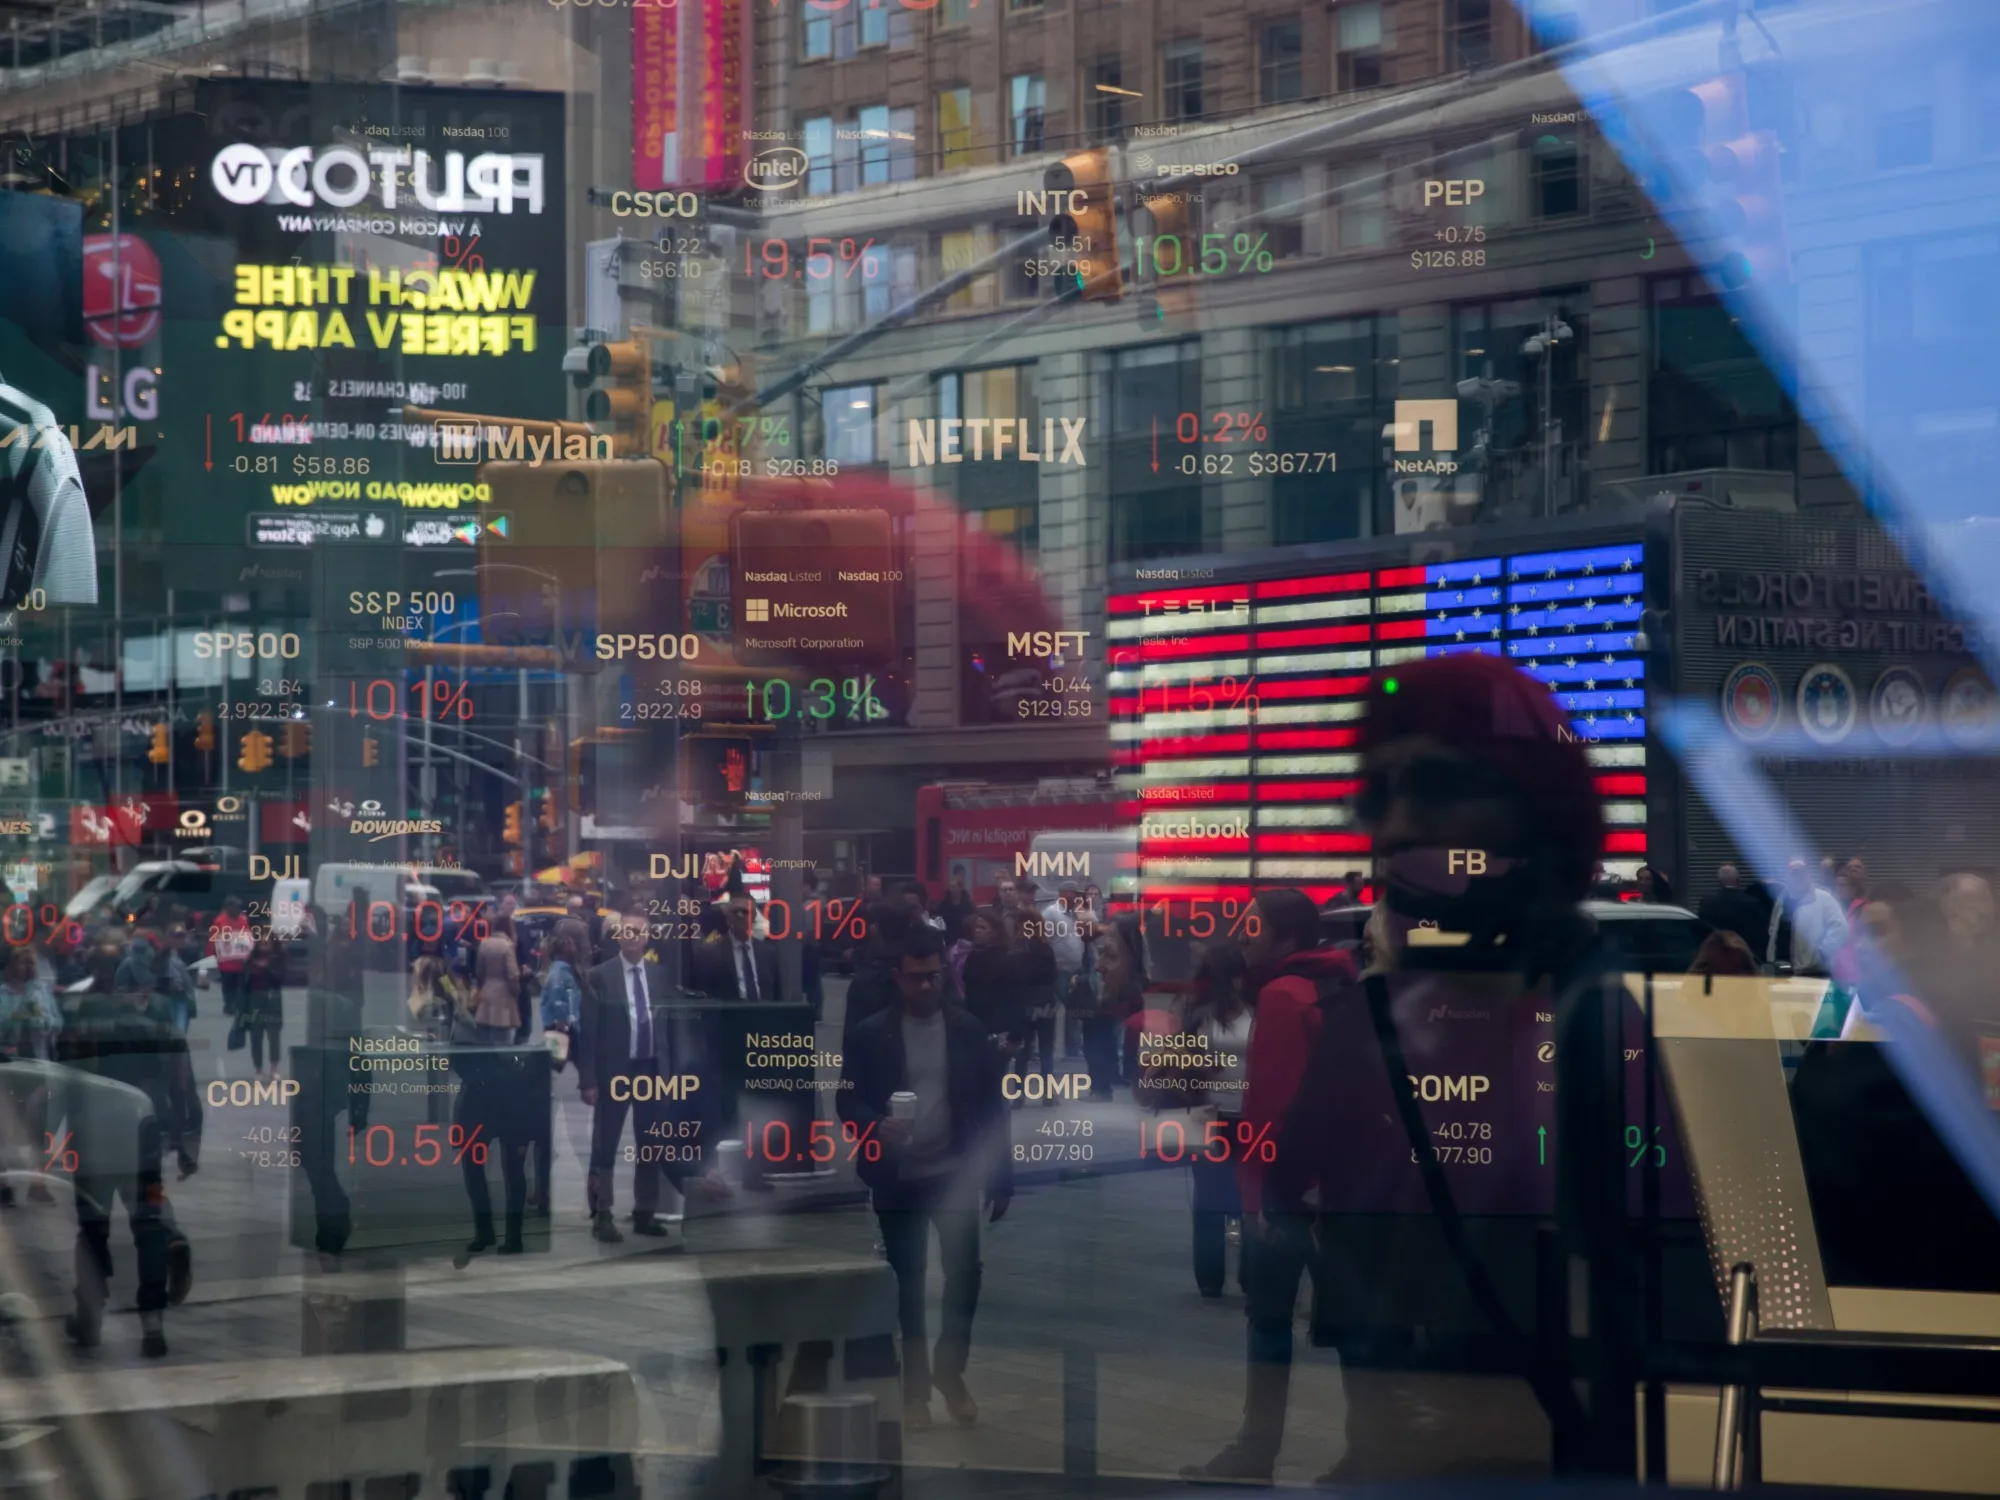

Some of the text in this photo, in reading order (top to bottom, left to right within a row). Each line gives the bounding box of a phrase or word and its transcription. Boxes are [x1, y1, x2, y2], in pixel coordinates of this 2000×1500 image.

[1531, 112, 1576, 124] Nasdaq
[443, 125, 509, 138] Nasdaq 100
[742, 129, 786, 142] Nasdaq
[1134, 126, 1178, 137] Nasdaq
[752, 156, 798, 177] intel
[1157, 163, 1240, 177] PEPSICO
[1016, 189, 1089, 216] INTC
[1424, 179, 1485, 207] PEP
[611, 191, 699, 218] CSCO
[1048, 235, 1092, 253] -5.51
[1434, 226, 1487, 244] +0.75
[761, 237, 879, 280] 9.5%
[1152, 232, 1274, 276] 0.5%
[1410, 249, 1487, 270] $126.88
[639, 260, 702, 279] $56.10
[1024, 258, 1092, 279] $52.09
[86, 364, 159, 420] LG
[1175, 412, 1268, 444] 0.2%
[487, 424, 614, 467] Mylan
[907, 416, 1087, 467] NETFLIX
[228, 453, 371, 476] -0.81 $58.86
[699, 456, 839, 478] +0.18 $26.86
[1173, 451, 1338, 478] -0.62 $367.71
[1393, 460, 1458, 475] NetApp
[744, 571, 788, 584] Nasdaq
[788, 570, 822, 582] Listed
[838, 570, 903, 583] Nasdaq 100
[1135, 568, 1214, 580] Nasdaq Listed
[349, 591, 456, 615] S&P 500
[772, 602, 848, 619] Microsoft
[382, 616, 424, 630] INDEX
[193, 631, 301, 659] SP500
[348, 638, 435, 650] S&P 500 Index
[595, 633, 700, 660] SP500
[745, 637, 865, 651] Microsoft Corporation
[1006, 630, 1091, 657] MSFT
[255, 679, 302, 696] -3.64
[654, 679, 702, 697] -3.68
[1041, 675, 1092, 694] +0.44
[366, 679, 475, 721] 0.1%
[762, 677, 882, 720] 0.3%
[619, 703, 702, 722] 2,922.49
[1017, 698, 1092, 719] $129.59
[745, 790, 822, 804] Nasdaq Traded
[1136, 787, 1215, 801] Nasdaq Listed
[1140, 816, 1250, 840] facebook
[249, 854, 300, 881] DJI
[439, 859, 462, 873] Avg
[648, 853, 699, 879] DJI
[766, 857, 818, 870] Company
[1014, 851, 1091, 878] MMM
[1447, 848, 1487, 875] FB
[643, 899, 701, 916] -24.86
[365, 900, 491, 943] 0.0%
[762, 898, 867, 940] 0.1%
[1154, 896, 1262, 939] 1.5%
[208, 924, 302, 944] 26,437.22
[610, 922, 701, 941] 26,437.22
[1022, 919, 1094, 939] $190.51
[349, 1035, 420, 1053] Nasdaq
[746, 1032, 815, 1050] Nasdaq
[1138, 1031, 1209, 1050] Nasdaq
[349, 1055, 450, 1074] Composite
[746, 1051, 843, 1070] Composite
[1138, 1050, 1238, 1069] Composite
[206, 1079, 301, 1108] COMP
[347, 1082, 461, 1096] NASDAQ Composite
[609, 1074, 700, 1102] COMP
[745, 1078, 855, 1092] NASDAQ Composite
[1001, 1073, 1092, 1100] COMP
[1138, 1077, 1250, 1092] NASDAQ Composite
[241, 1126, 302, 1144] -40.42
[643, 1121, 702, 1139] -40.67
[1034, 1120, 1094, 1138] -40.78
[1432, 1122, 1492, 1140] -40.78
[364, 1123, 489, 1168] 0.5%
[762, 1120, 882, 1163] 0.5%
[1155, 1120, 1278, 1164] 0.5%
[623, 1145, 702, 1165] 8,078.01
[1013, 1144, 1094, 1163] 8,077.90
